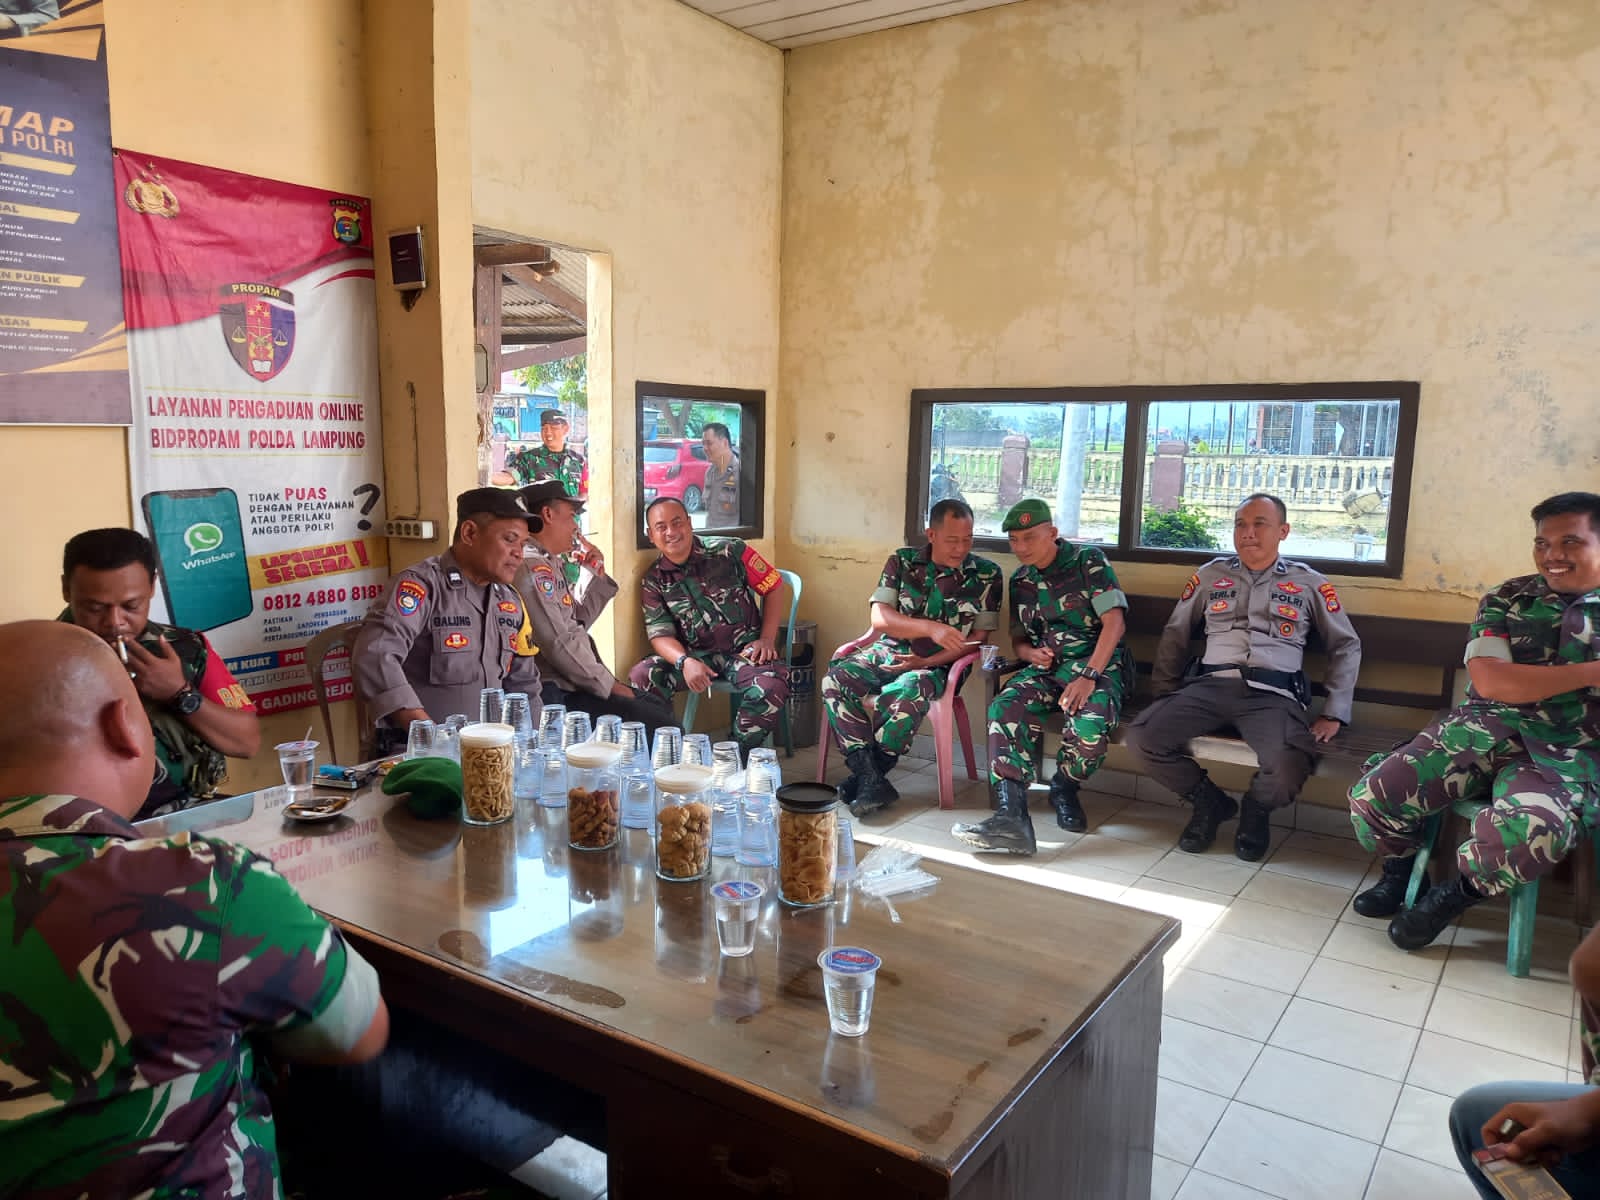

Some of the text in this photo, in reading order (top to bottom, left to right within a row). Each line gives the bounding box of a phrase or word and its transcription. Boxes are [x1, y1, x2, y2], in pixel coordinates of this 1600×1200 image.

[12, 130, 73, 158] POLRI
[16, 272, 60, 284] PUBLIK
[231, 284, 281, 298] PROPAM
[149, 396, 365, 422] LAYANAN PENGADUAN ONLINE
[151, 428, 366, 449] BIDPROPAM POLDA LAMPUNG
[249, 487, 327, 502] TIDAK PUAS
[249, 501, 355, 513] DENGAN PELAYANAN
[251, 513, 331, 525] ATAU PERILAKU
[252, 522, 334, 536] ANGGOTA POLRI
[182, 552, 236, 570] WhatsApp
[260, 544, 348, 569] LAPORKAN
[264, 556, 355, 584] SEGERA
[263, 593, 302, 611] 0812
[306, 588, 347, 606] 4880
[1271, 593, 1303, 608] POLRI
[241, 656, 271, 669] KUAT
[262, 689, 317, 709] GADING
